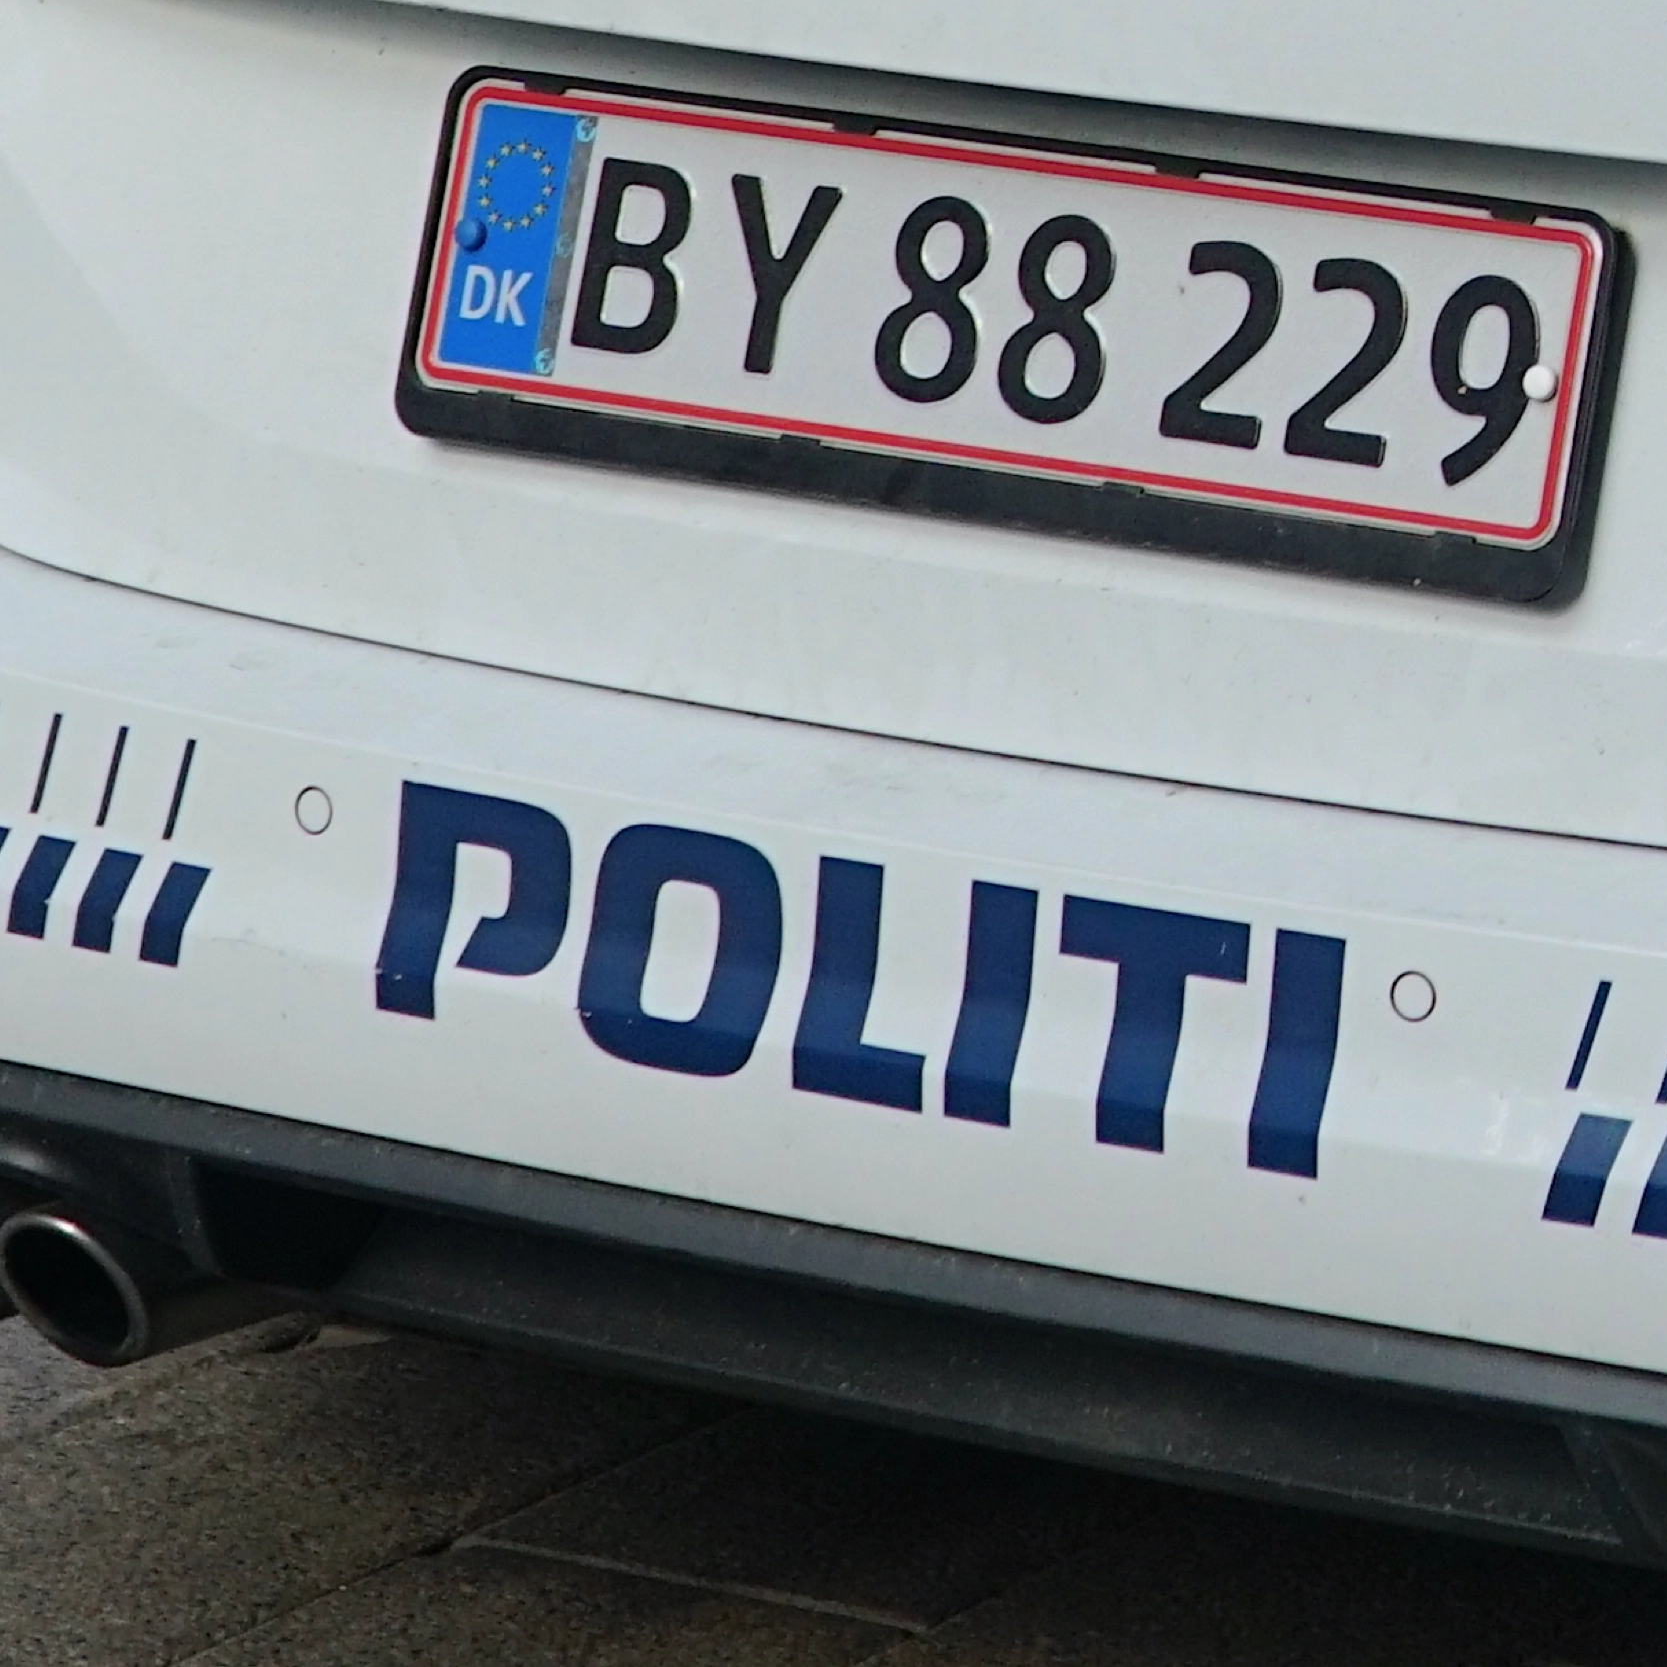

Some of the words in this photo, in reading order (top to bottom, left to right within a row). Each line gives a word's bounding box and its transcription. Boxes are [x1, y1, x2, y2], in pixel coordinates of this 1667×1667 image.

[458, 263, 530, 328] DK
[571, 156, 844, 375] BY
[873, 194, 1116, 425] 88
[1158, 240, 1541, 488] 229
[374, 779, 1347, 1180] POLITI
